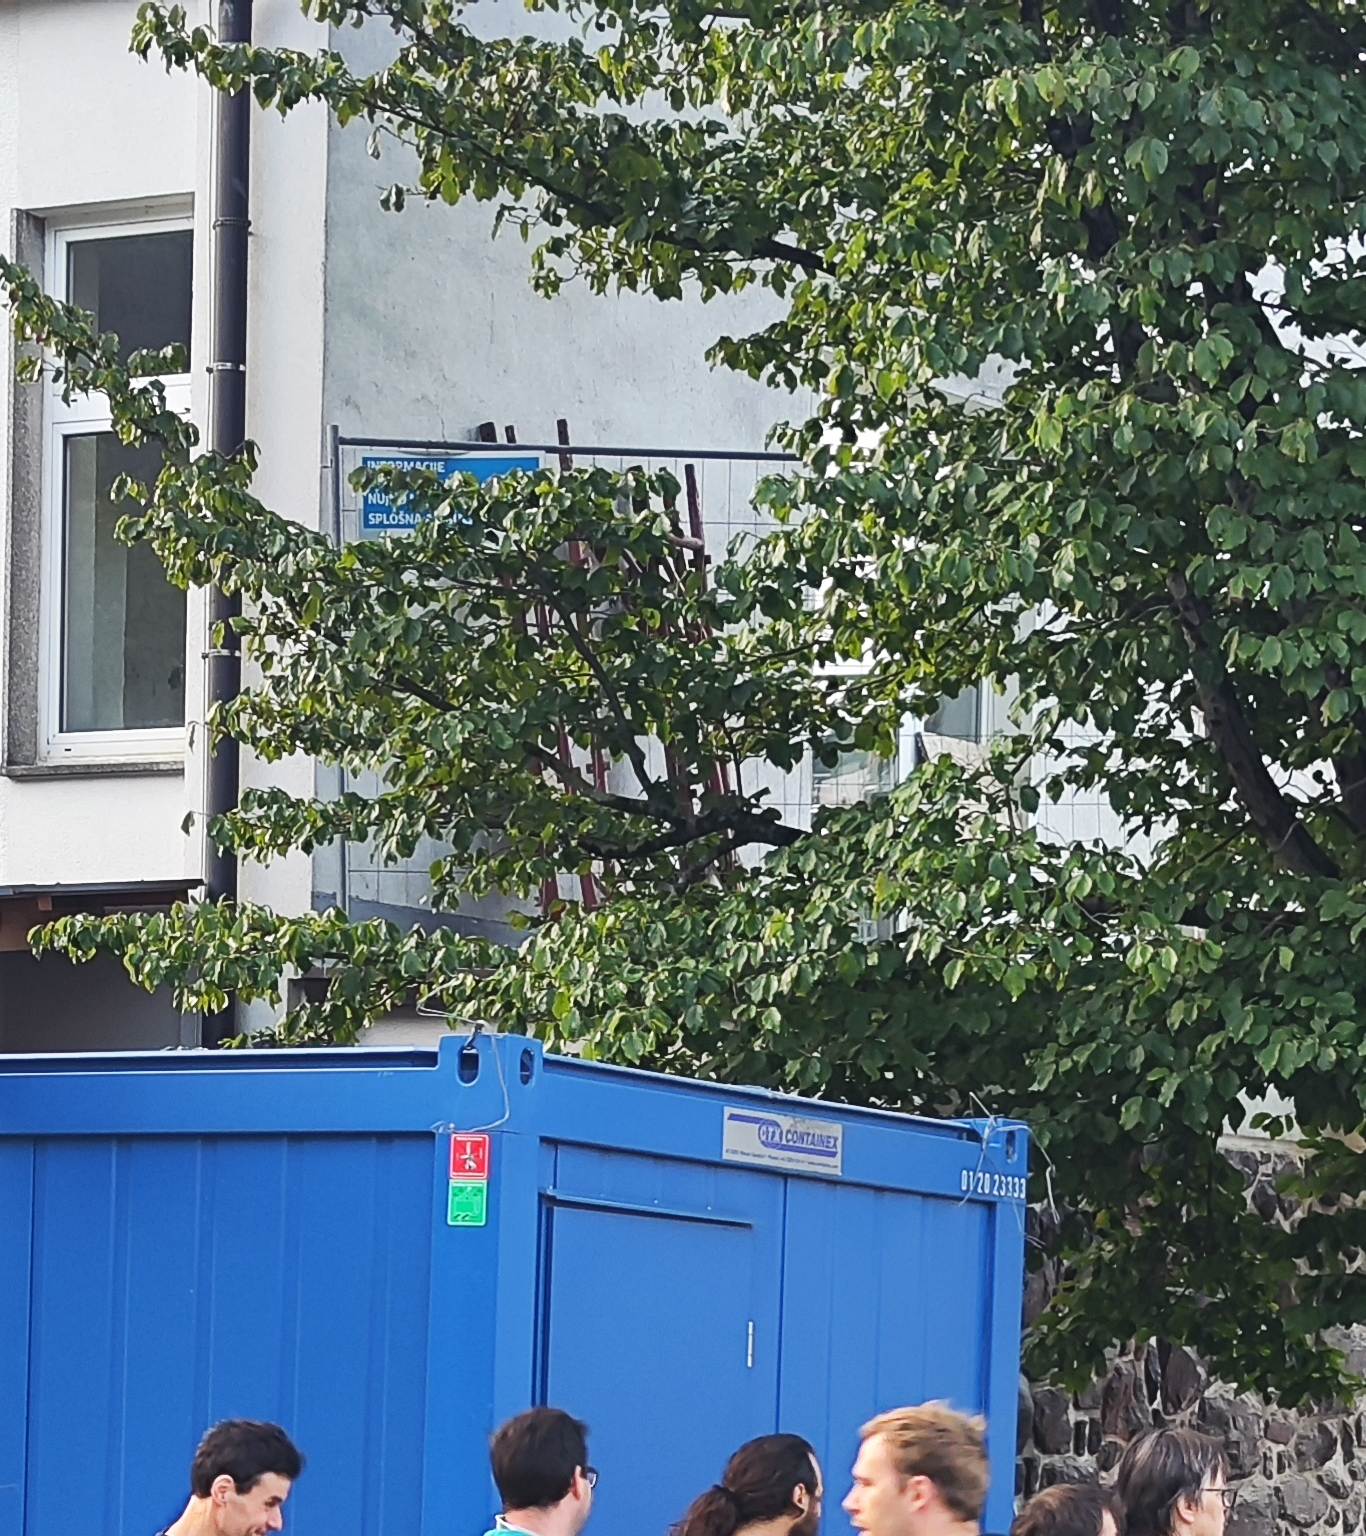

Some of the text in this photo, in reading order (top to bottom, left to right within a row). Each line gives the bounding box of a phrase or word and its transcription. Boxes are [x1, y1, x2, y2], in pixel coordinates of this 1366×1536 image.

[368, 510, 422, 525] SPLOŠNA
[784, 1128, 839, 1150] CONTAINEX
[961, 1170, 974, 1191] 01
[977, 1172, 991, 1194] 20
